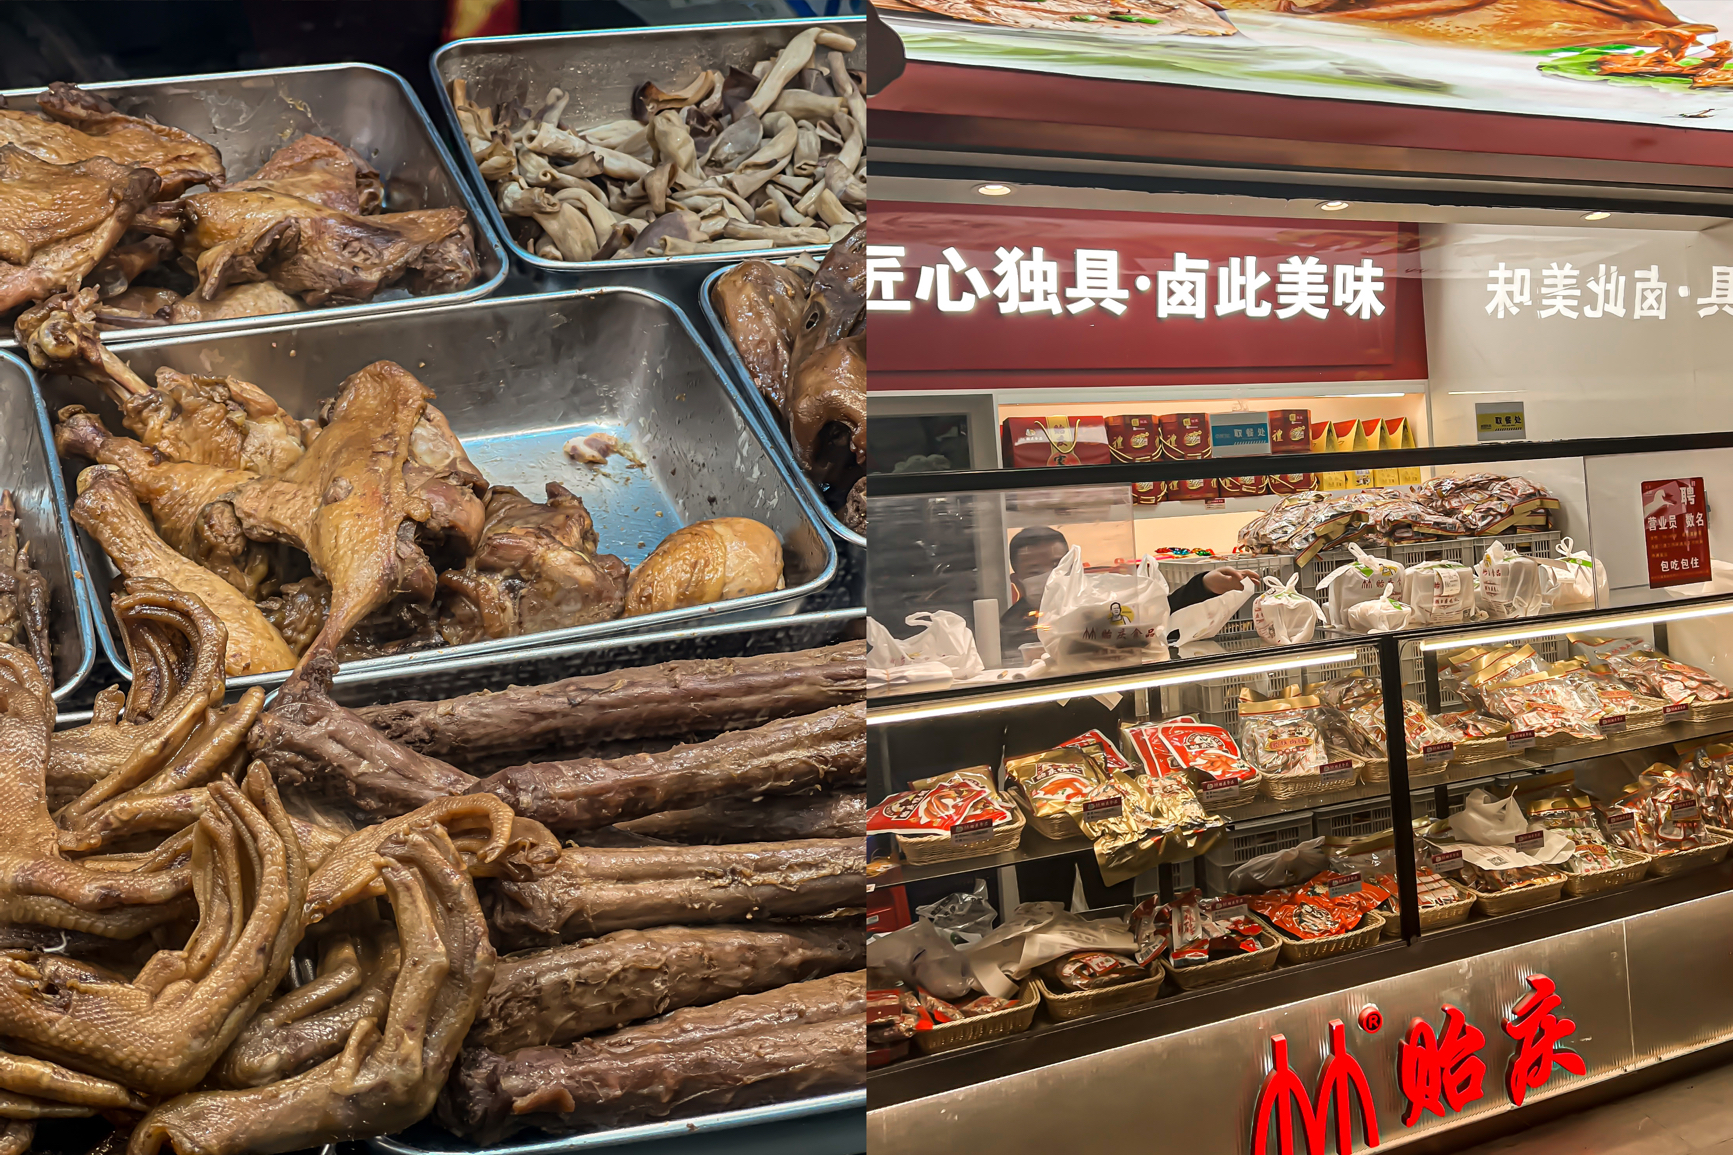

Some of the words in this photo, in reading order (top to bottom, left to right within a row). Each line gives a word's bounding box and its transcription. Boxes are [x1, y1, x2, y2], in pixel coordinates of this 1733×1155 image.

[1494, 415, 1522, 425] 取餐处
[1233, 427, 1266, 439] 取餐处
[1681, 486, 1696, 507] 聘
[1647, 514, 1678, 532] 营业员
[1685, 511, 1705, 528] 数名
[1660, 557, 1700, 571] 包吃包住
[1397, 973, 1587, 1129] 贻庆
